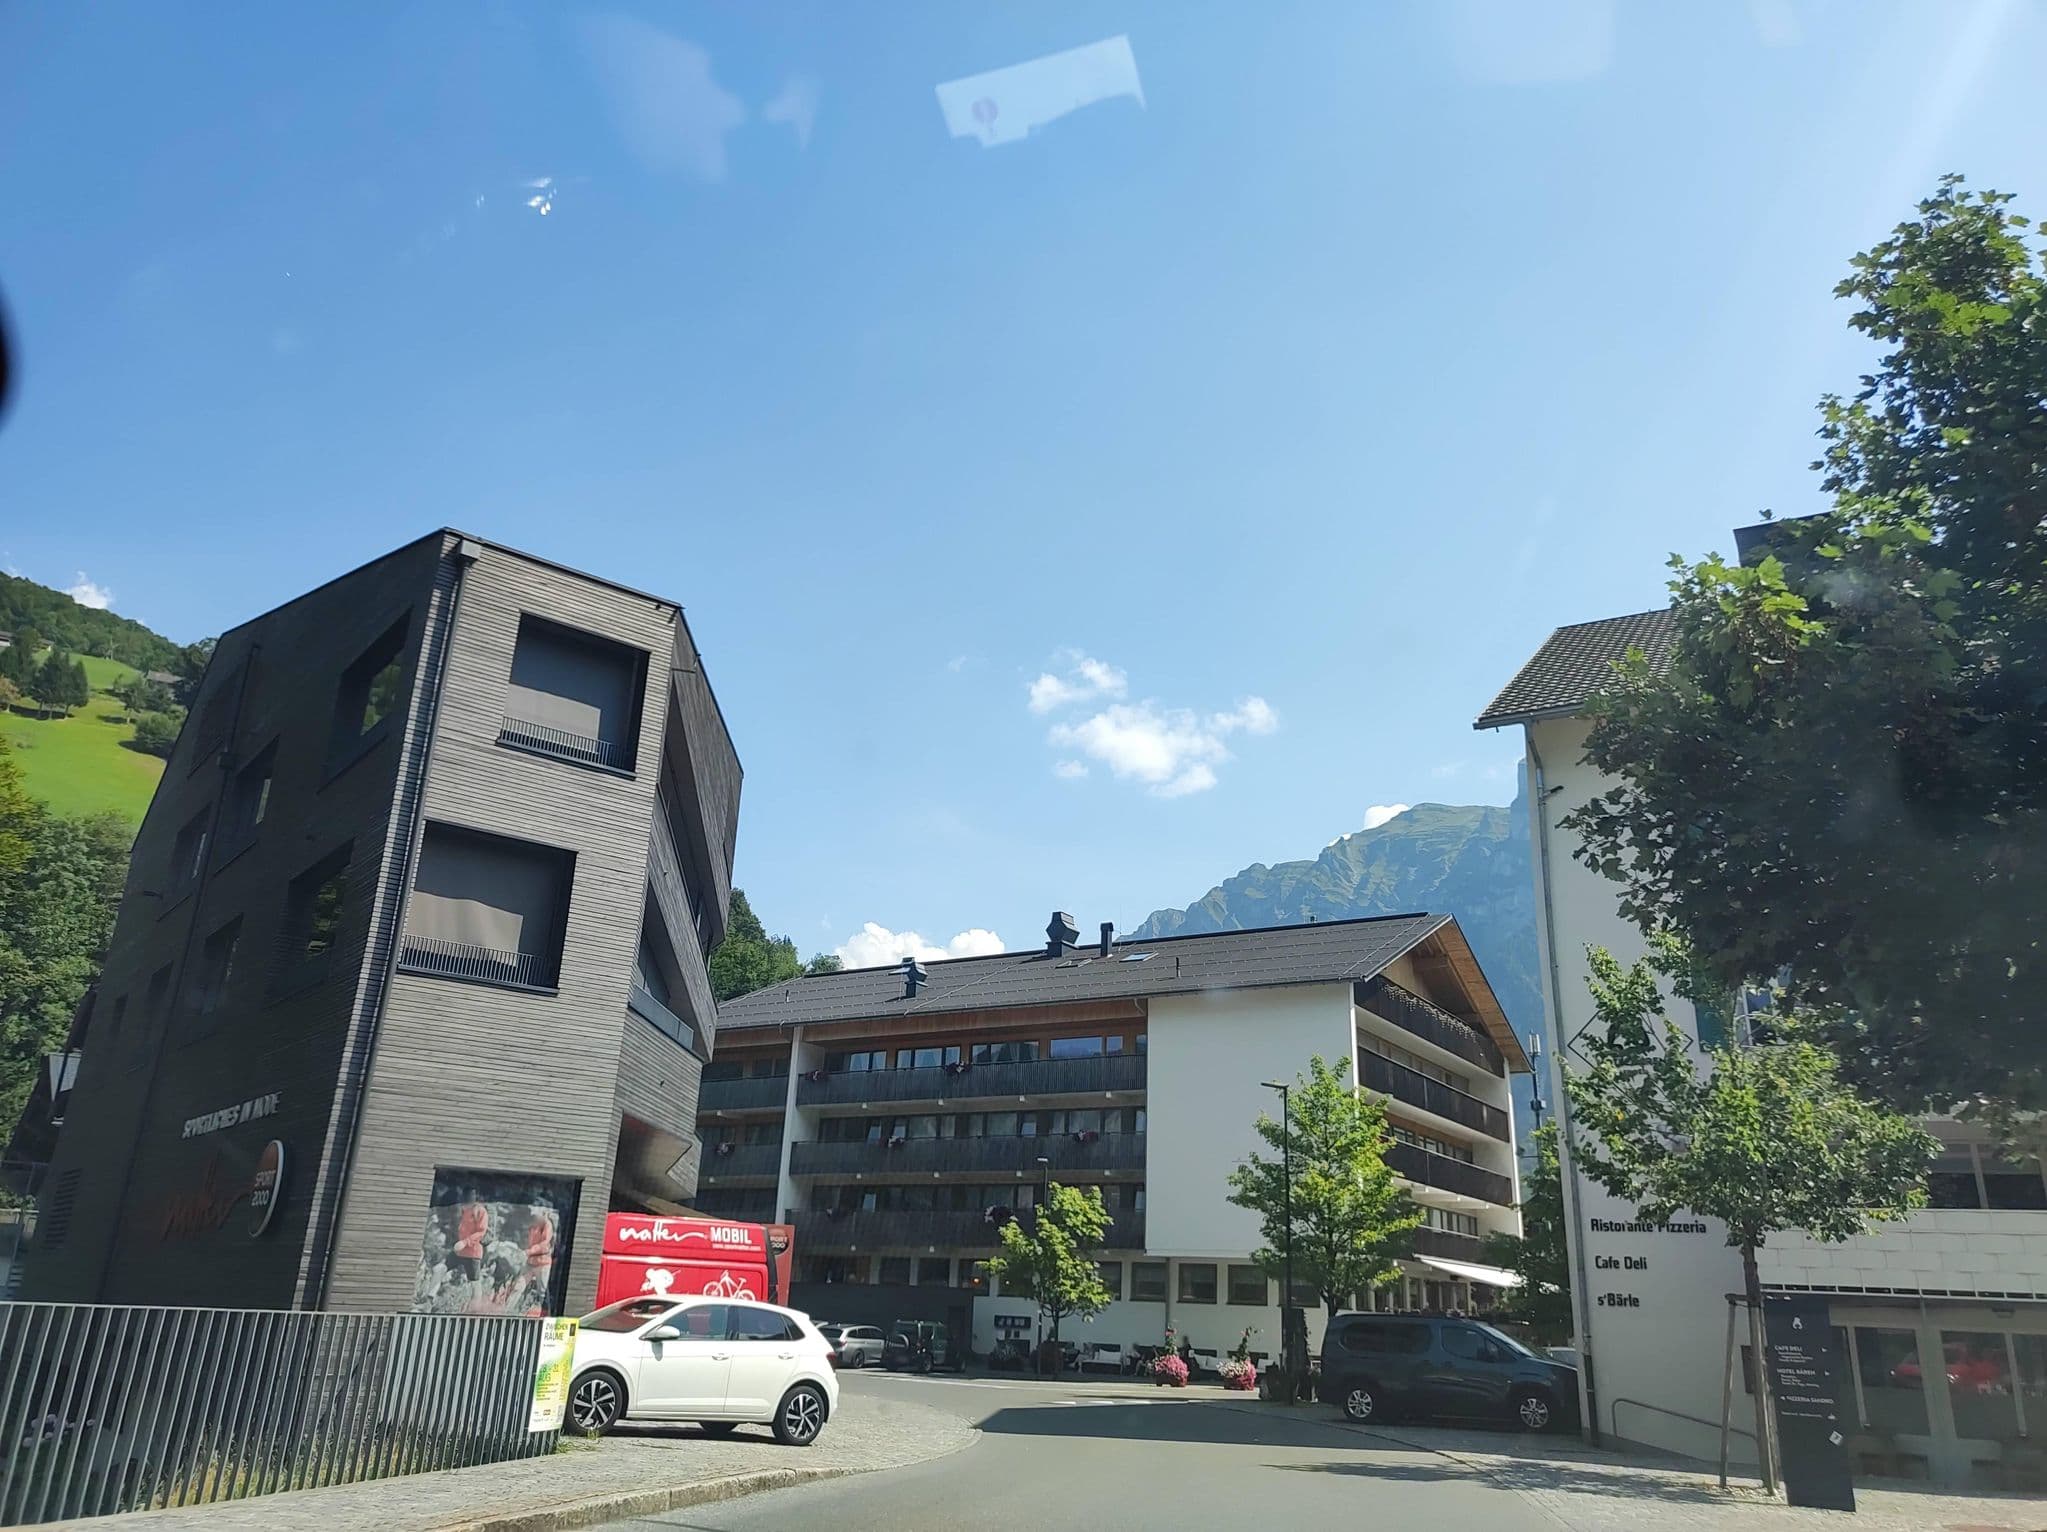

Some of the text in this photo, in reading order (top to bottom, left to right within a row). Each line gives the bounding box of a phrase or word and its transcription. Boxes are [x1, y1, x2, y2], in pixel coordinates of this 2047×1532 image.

[255, 1170, 276, 1187] SPORT
[251, 1190, 270, 1206] 2000
[1590, 1218, 1707, 1234] Ristorante Pizzeria
[710, 1226, 753, 1244] MOBIL
[1594, 1255, 1648, 1271] Cafe Deli
[1597, 1292, 1641, 1308] s'Bärle
